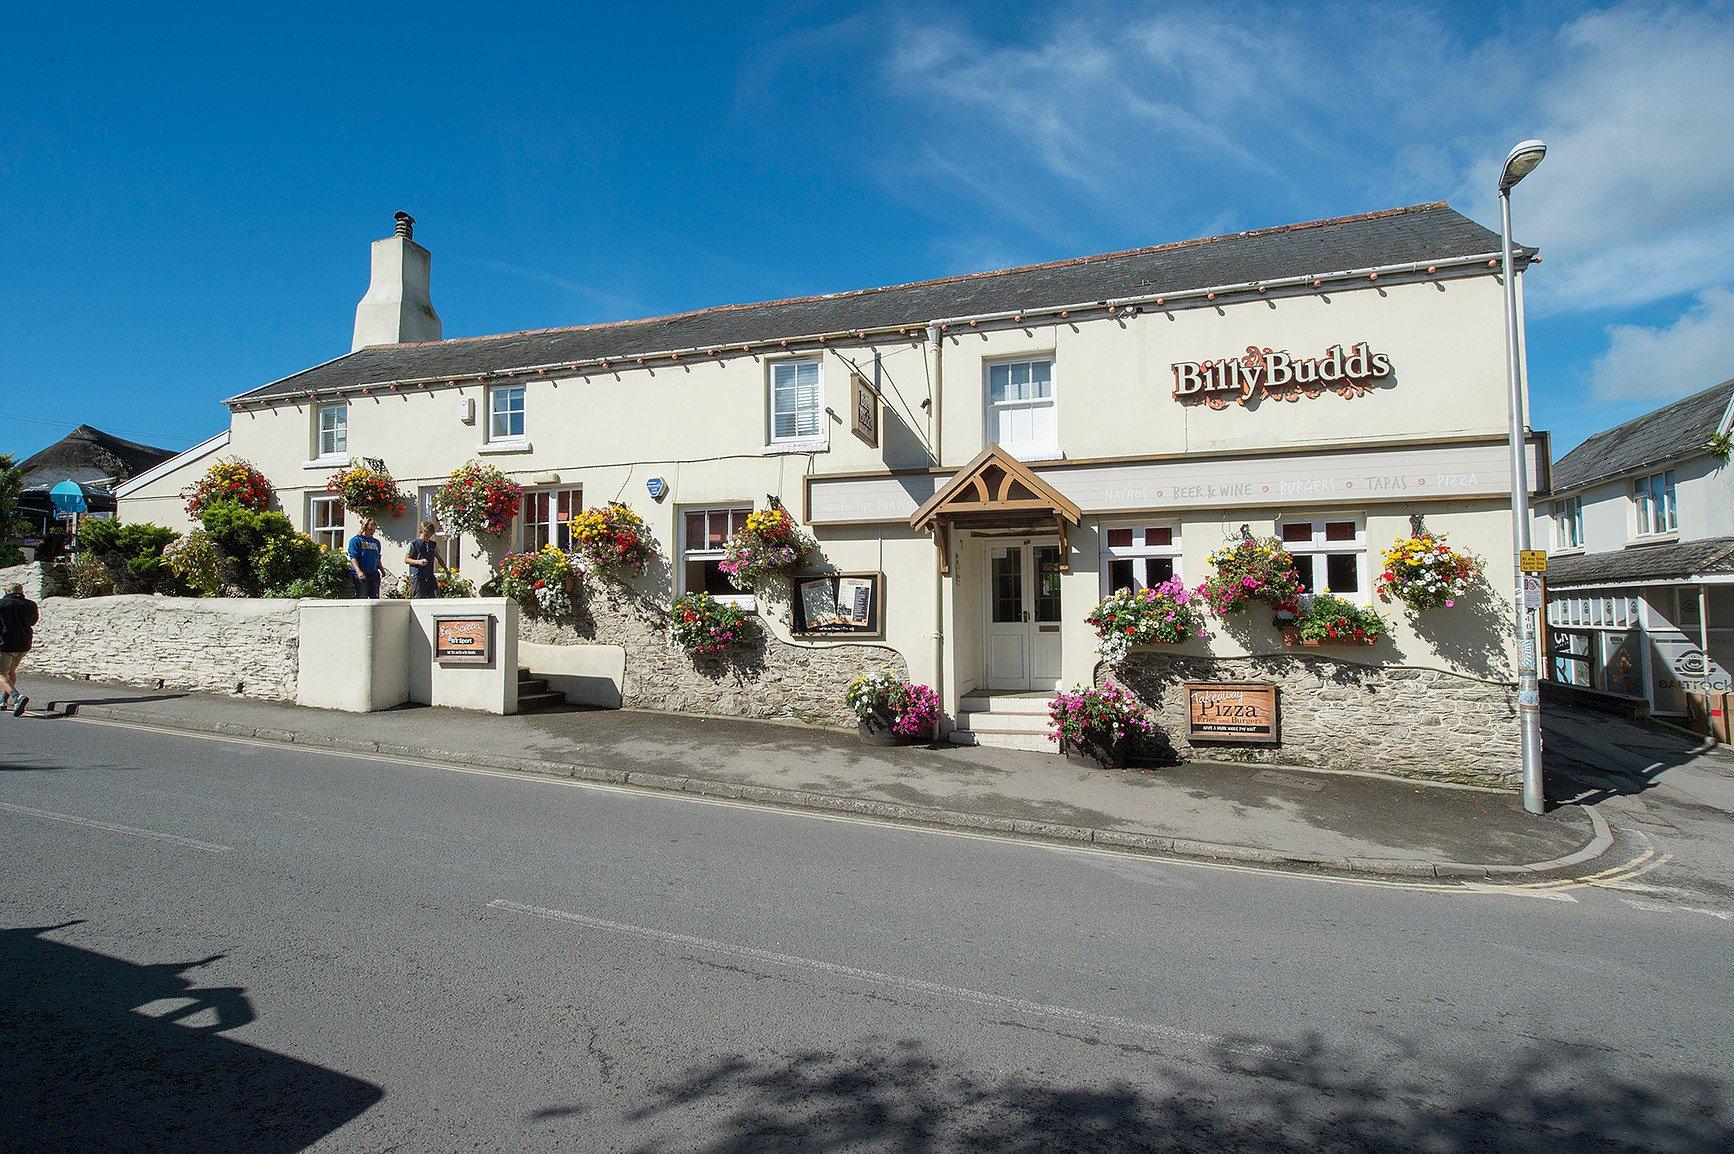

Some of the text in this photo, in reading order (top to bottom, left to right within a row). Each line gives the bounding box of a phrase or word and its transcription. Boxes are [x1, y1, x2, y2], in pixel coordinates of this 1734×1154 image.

[1174, 342, 1391, 400] Billy Budds
[1105, 473, 1479, 502] NACHOS BEER & WINE BURGERS TAPAS PIZZA
[1191, 691, 1243, 706] Takeaway
[1200, 701, 1257, 718] Pizza
